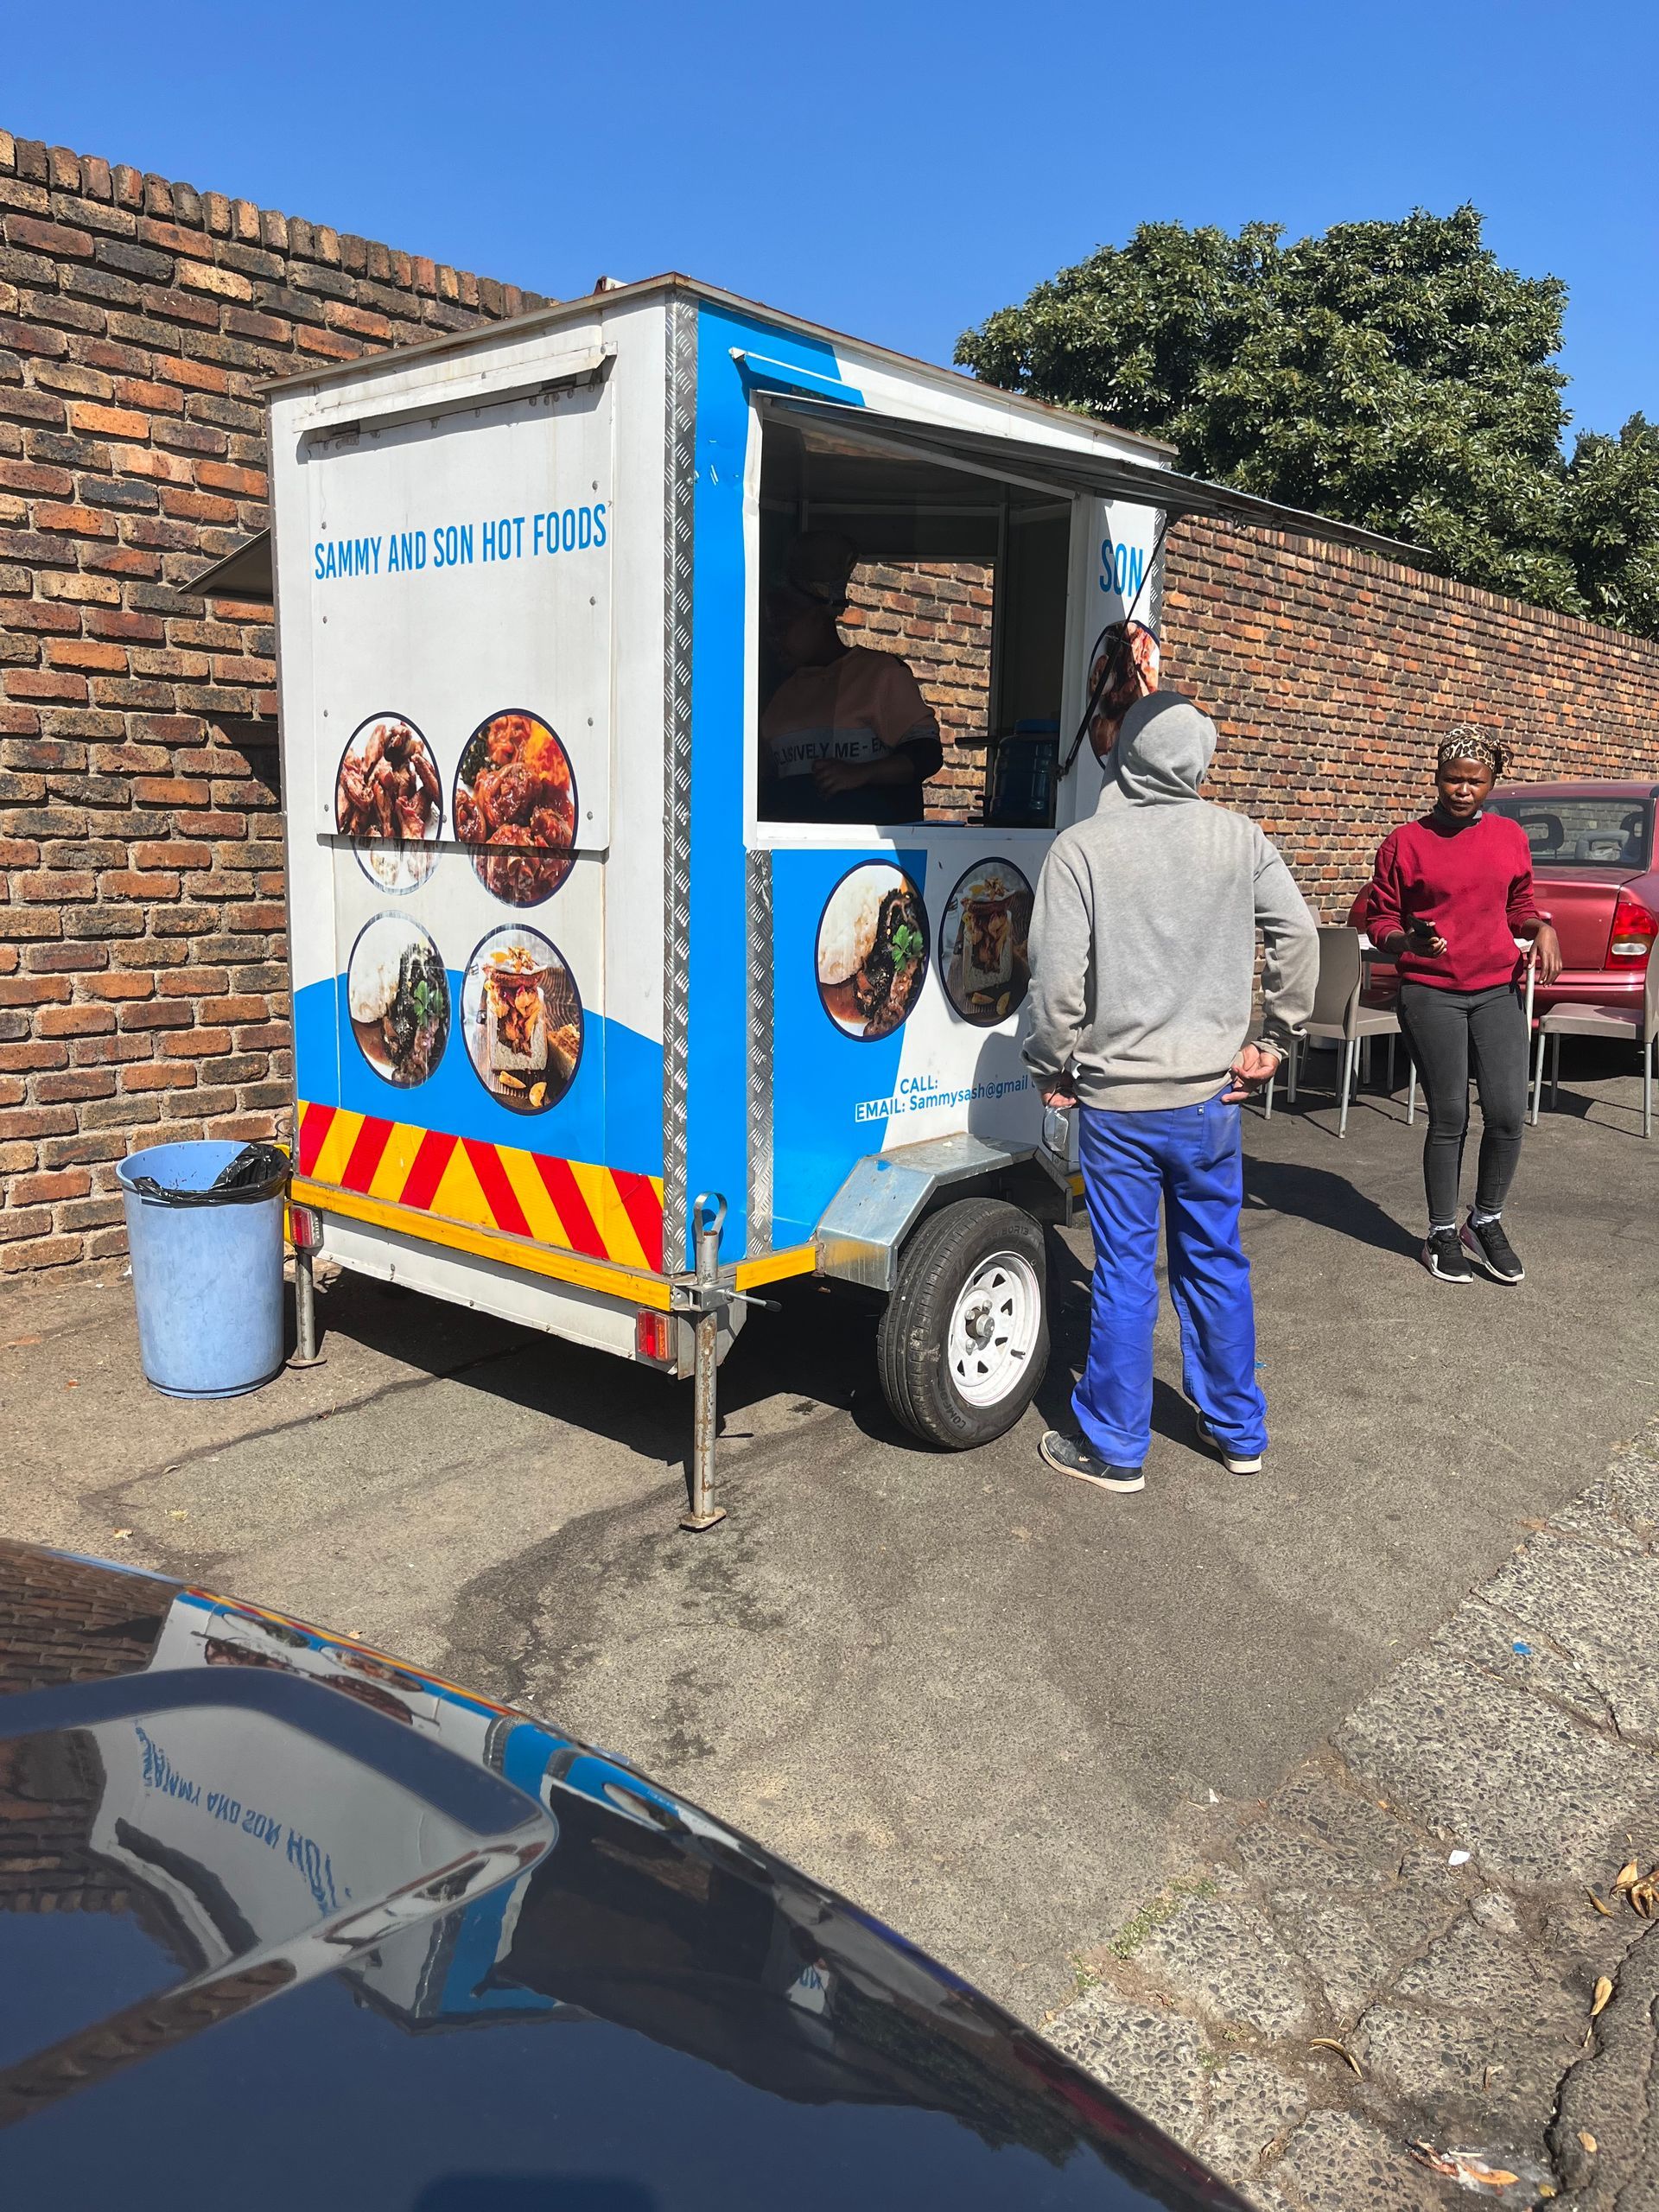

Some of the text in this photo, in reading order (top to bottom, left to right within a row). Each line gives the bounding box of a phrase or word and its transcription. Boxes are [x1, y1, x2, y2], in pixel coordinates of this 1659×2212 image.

[315, 503, 607, 581] SAMMY AND SON HOT FOODS
[1099, 538, 1143, 597] SON
[835, 741, 861, 759] ME
[899, 1075, 938, 1095] CALL:
[856, 1098, 906, 1121] EMAIL:
